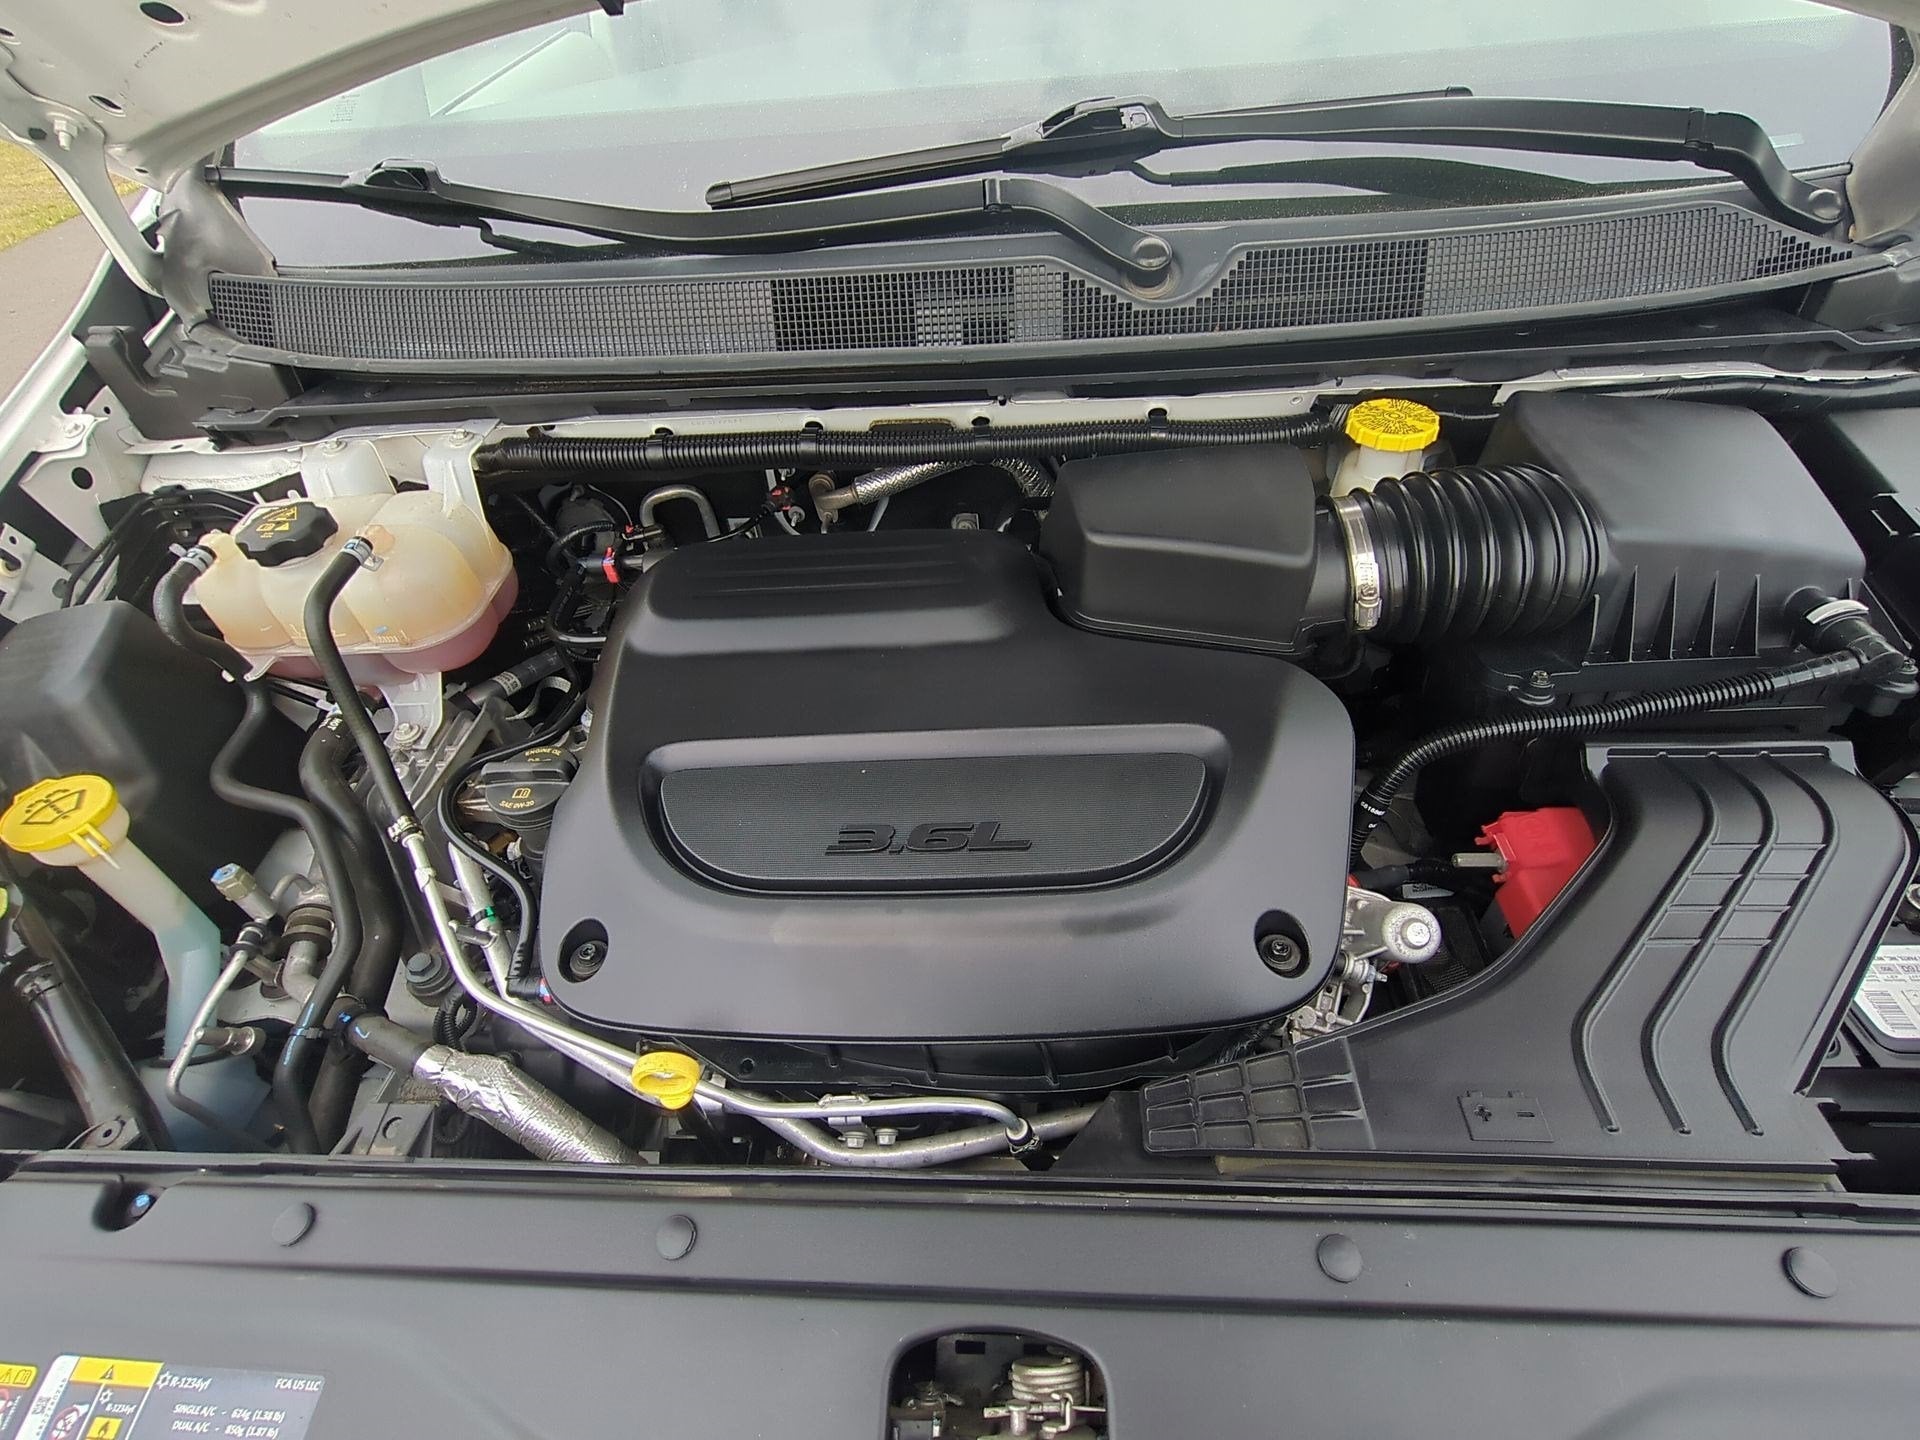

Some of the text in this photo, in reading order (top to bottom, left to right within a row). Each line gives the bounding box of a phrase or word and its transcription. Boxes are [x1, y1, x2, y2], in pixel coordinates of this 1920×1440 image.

[525, 748, 551, 756] ENGINE
[499, 800, 513, 809] SAE
[825, 821, 1032, 856] 3.6L
[170, 1374, 212, 1392] R-1234yf
[275, 1378, 321, 1391] FCA US LLC
[173, 1404, 201, 1415] SINGLE
[200, 1405, 217, 1416] A/C
[172, 1420, 195, 1431] DUAL
[193, 1421, 211, 1433] A/C
